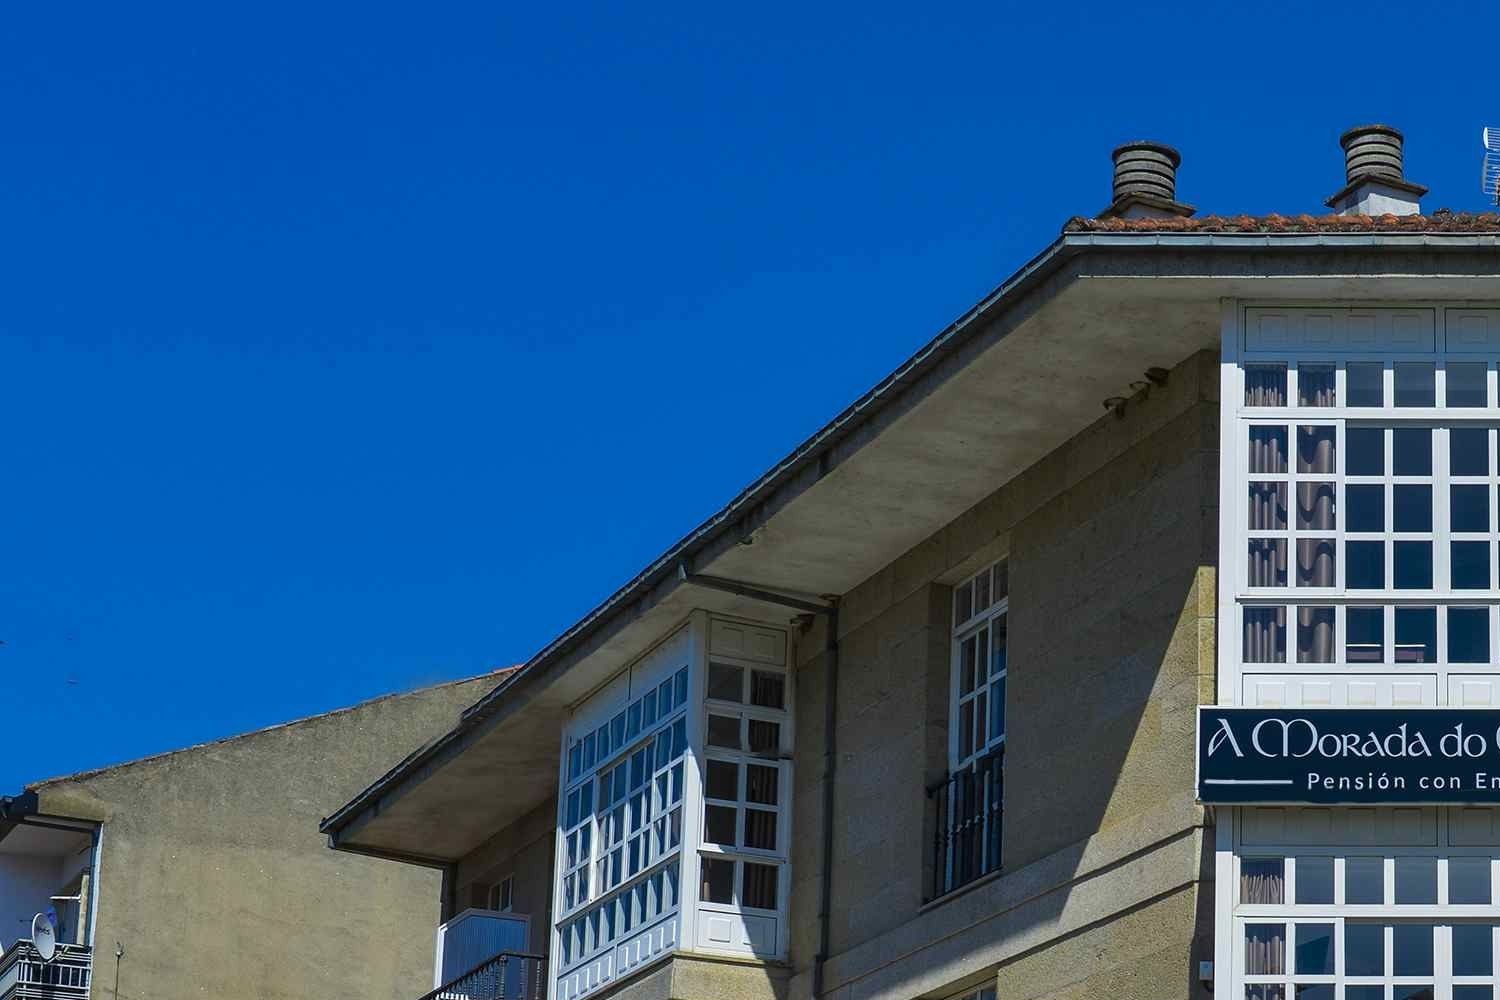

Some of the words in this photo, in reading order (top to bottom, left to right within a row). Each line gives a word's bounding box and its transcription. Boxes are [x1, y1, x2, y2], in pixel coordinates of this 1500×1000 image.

[1207, 718, 1245, 757] A
[1439, 722, 1487, 758] do
[1307, 772, 1405, 790] Pensión
[1419, 776, 1461, 790] con
